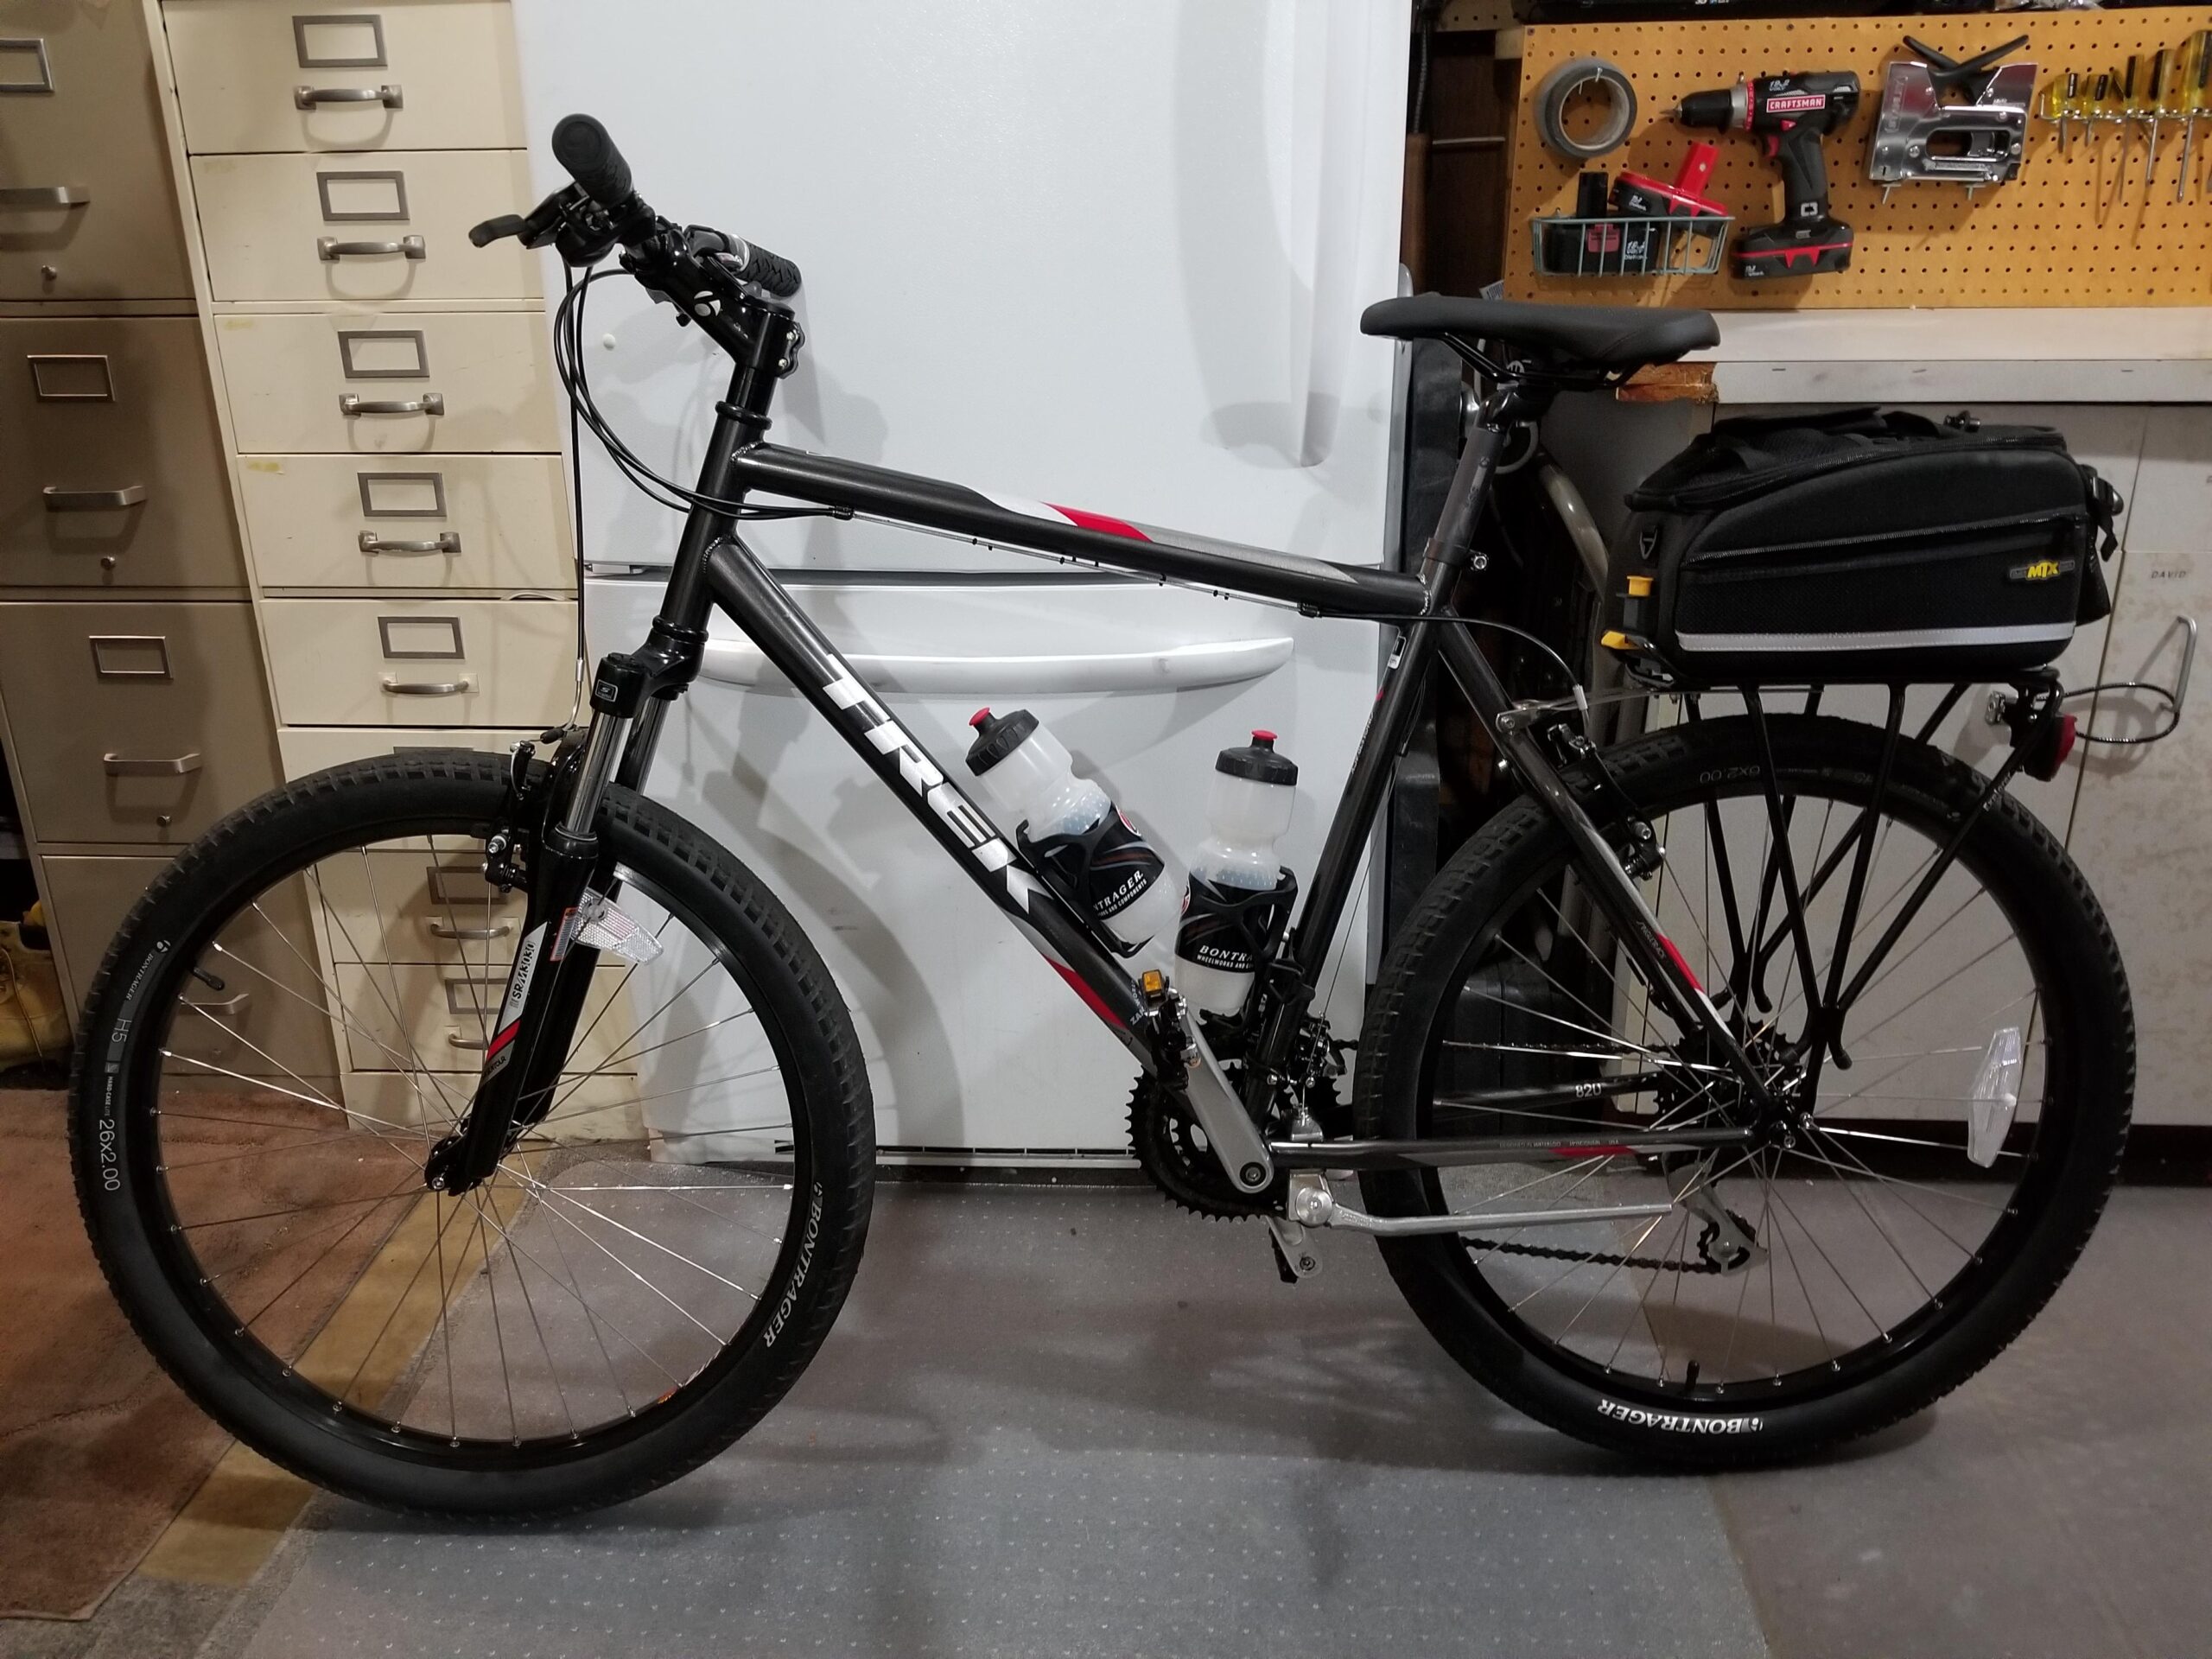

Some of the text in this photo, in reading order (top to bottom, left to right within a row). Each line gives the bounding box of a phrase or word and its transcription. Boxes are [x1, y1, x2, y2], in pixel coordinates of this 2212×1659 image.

[1770, 98, 1822, 110] CRAFTSMAN
[2027, 562, 2058, 578] MTX
[2151, 570, 2187, 579] DAVID
[822, 653, 1054, 914] TREK
[1700, 766, 1760, 784] 6x2.00
[1093, 870, 1144, 911] NTRAGER
[1197, 954, 1234, 968] WHEELWORKS
[1199, 944, 1253, 962] BONTRA
[125, 952, 154, 1001] BONTRAGER
[111, 1018, 132, 1043] H5
[1575, 1083, 1602, 1098] 820
[99, 1119, 120, 1192] 26x2.00
[763, 1200, 823, 1348] BONTRAGER
[1598, 1399, 1743, 1434] BONTRAGER
